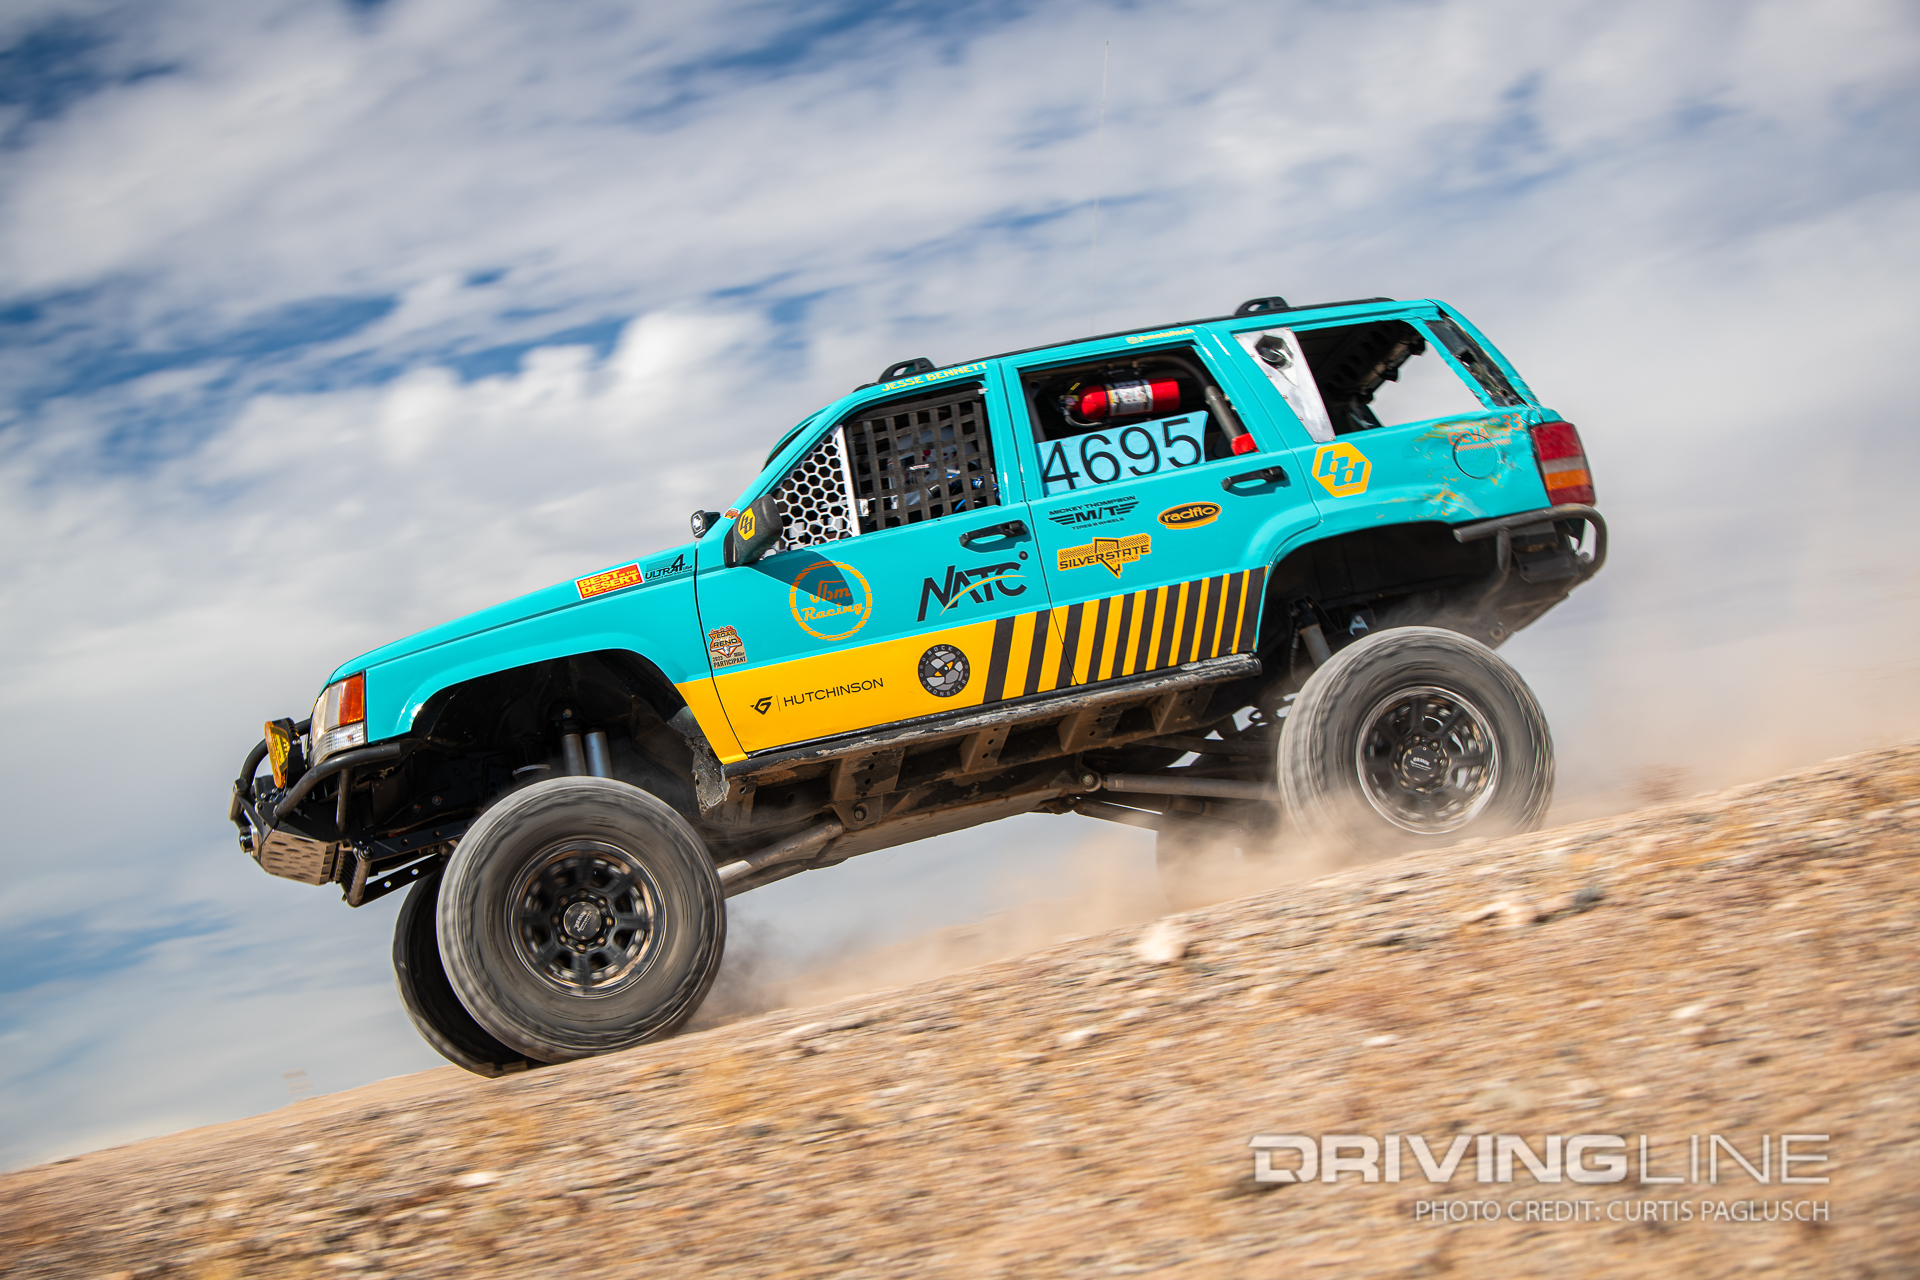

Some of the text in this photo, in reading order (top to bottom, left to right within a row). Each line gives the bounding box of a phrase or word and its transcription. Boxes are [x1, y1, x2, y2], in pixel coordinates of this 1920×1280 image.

[881, 362, 988, 391] JESSE BENNETT
[1043, 417, 1202, 490] 4695
[1049, 495, 1136, 516] MICKEY THOMPSON
[1074, 506, 1119, 522] M/T
[1164, 506, 1216, 522] radflo
[579, 570, 620, 588] BEST
[581, 574, 639, 595] DESERT
[917, 562, 1028, 622] NATC
[801, 602, 865, 621] Racing
[711, 630, 736, 640] VEGAS
[713, 638, 738, 648] RENO
[927, 645, 953, 656] ROCK
[713, 656, 746, 668] PARTICIPANT
[783, 677, 884, 707] HUTCHINSON
[926, 679, 967, 697] MONSTER
